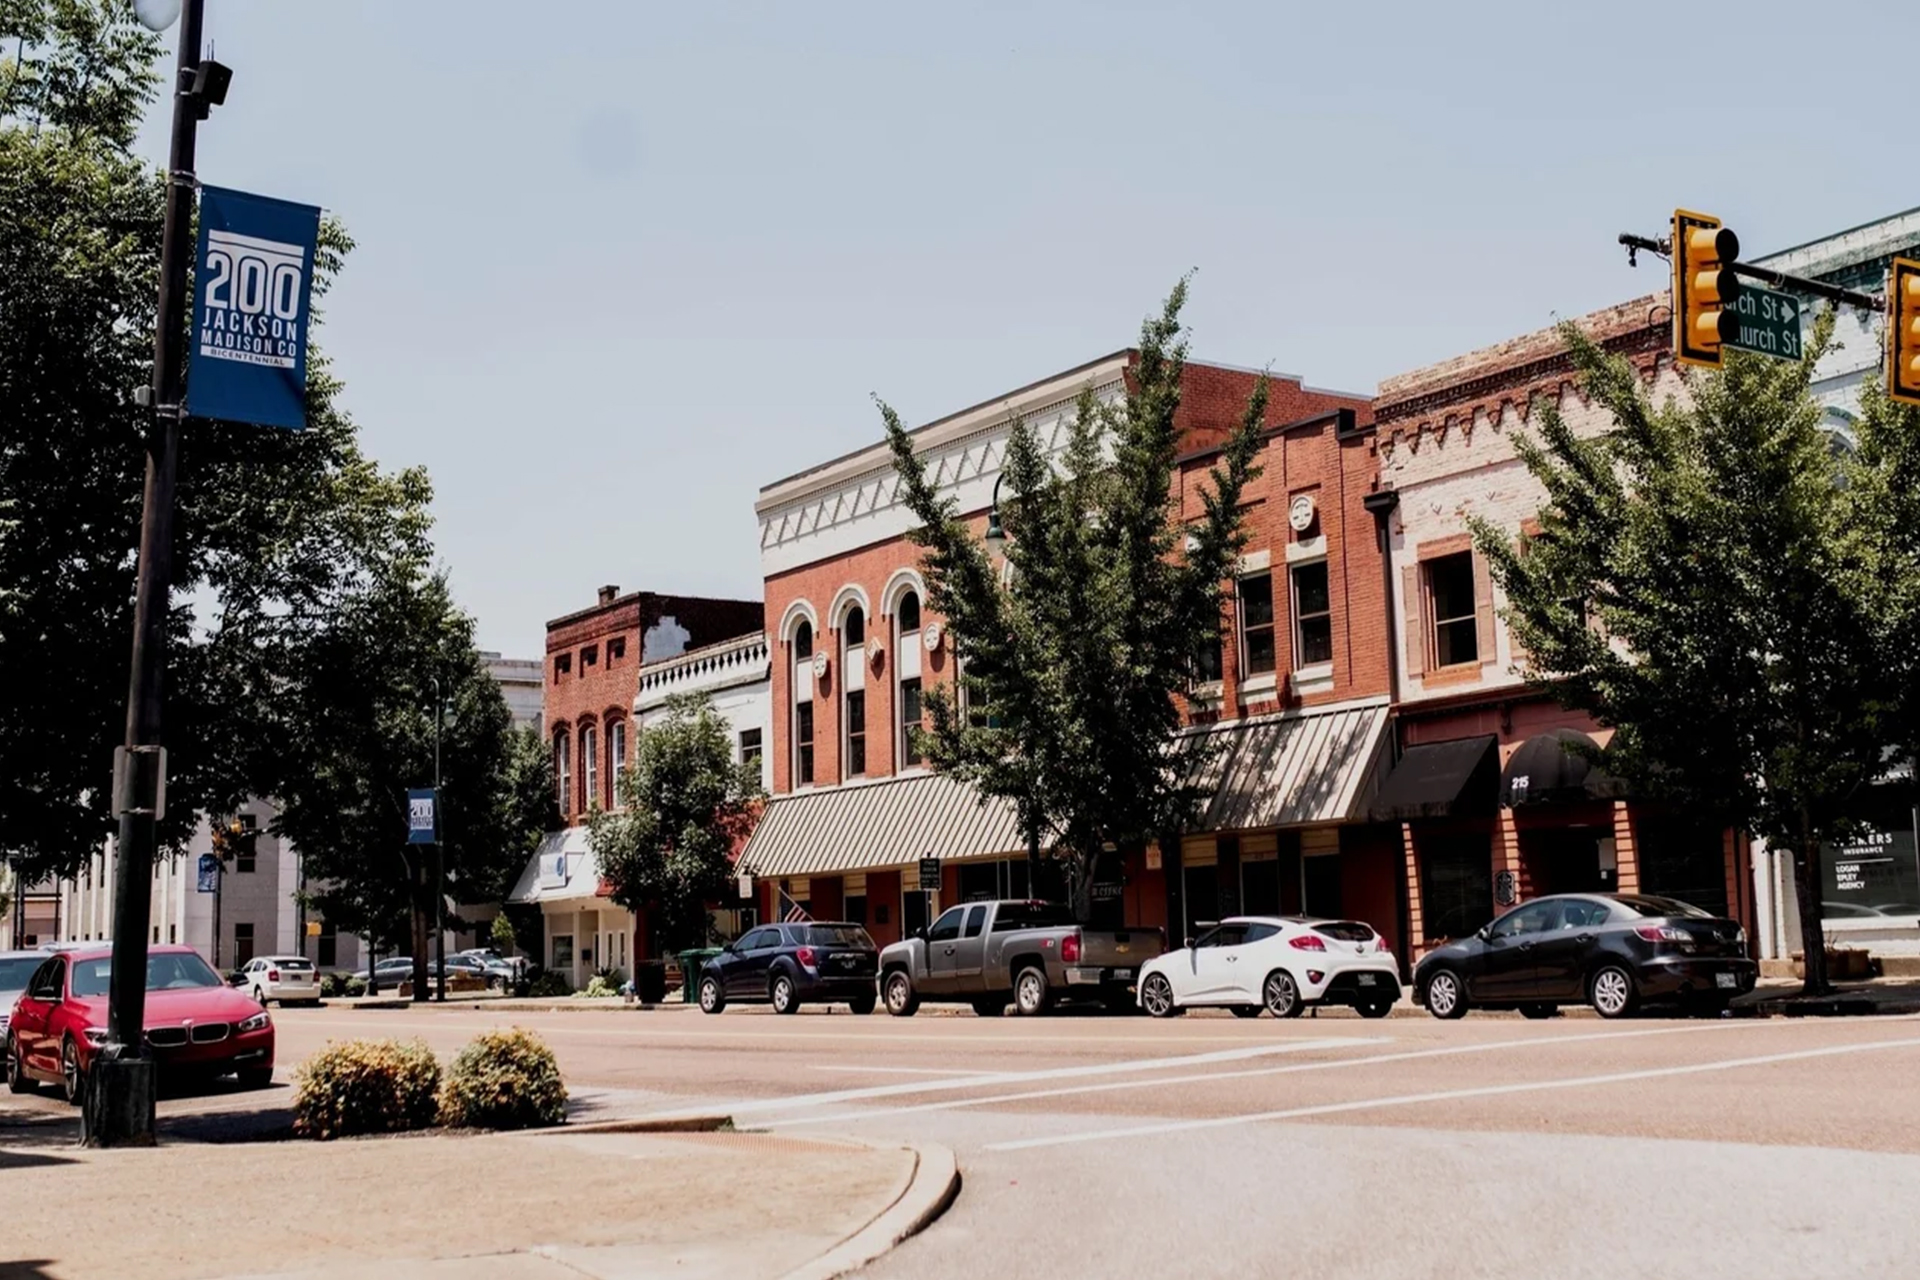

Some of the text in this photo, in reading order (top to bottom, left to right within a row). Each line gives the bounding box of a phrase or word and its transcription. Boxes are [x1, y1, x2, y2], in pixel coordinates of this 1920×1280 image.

[205, 251, 302, 321] 200
[1762, 294, 1779, 321] St
[202, 308, 297, 341] JACKSON
[201, 329, 297, 357] MADISON CO
[1735, 325, 1799, 357] urch St
[210, 348, 285, 366] BICENTENNIAL
[410, 802, 433, 818] 200
[1843, 846, 1883, 856] INSURANCE
